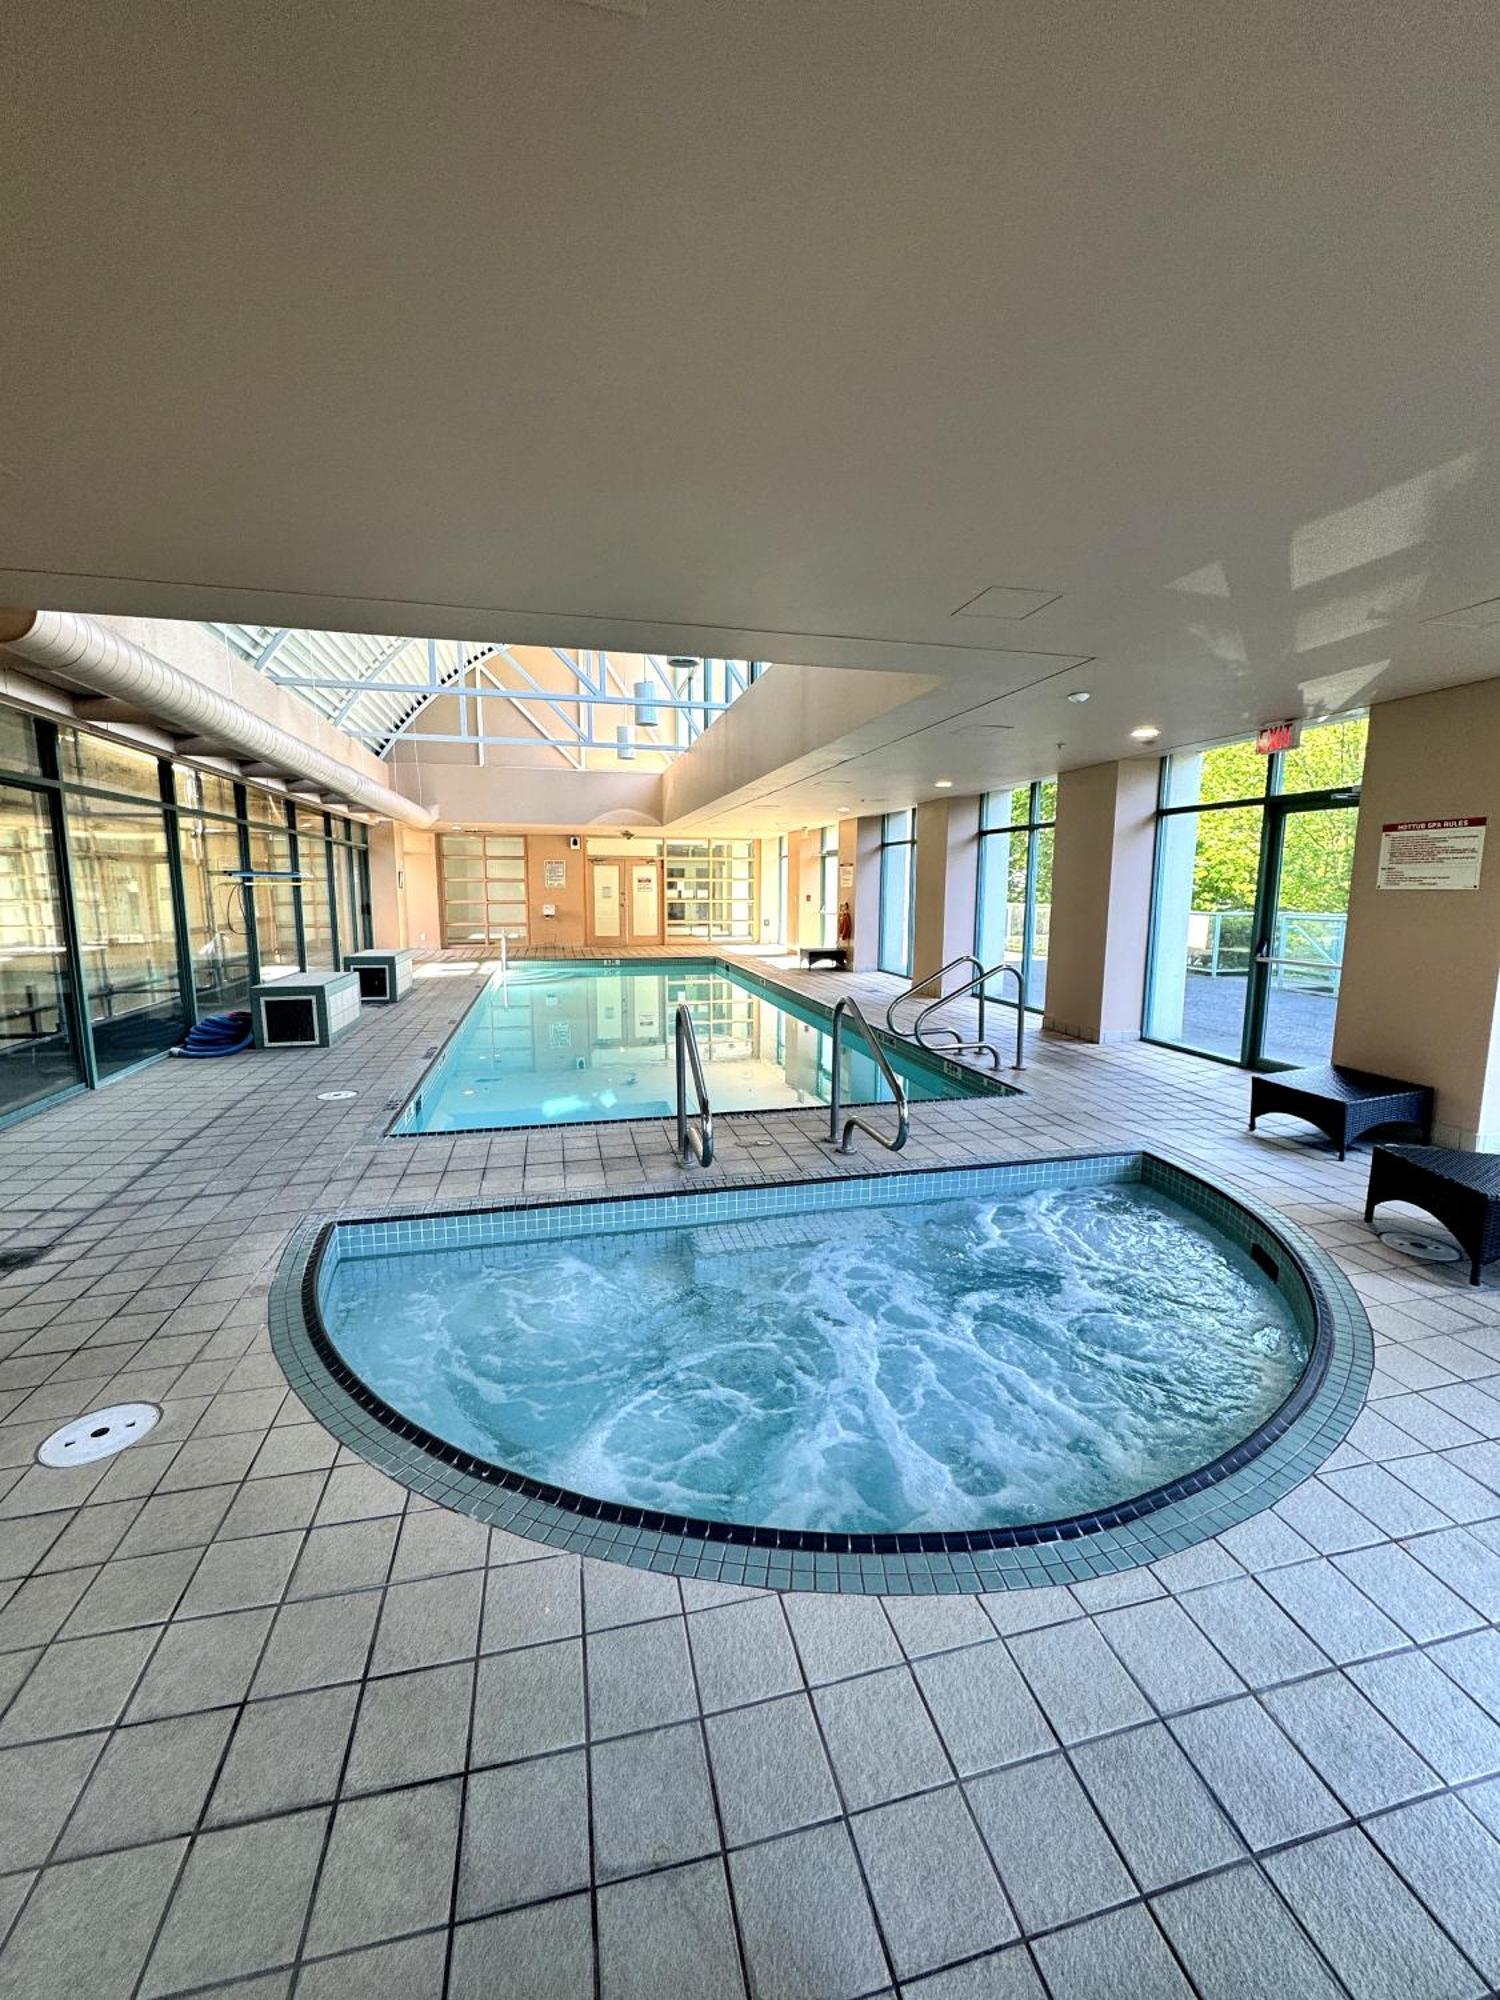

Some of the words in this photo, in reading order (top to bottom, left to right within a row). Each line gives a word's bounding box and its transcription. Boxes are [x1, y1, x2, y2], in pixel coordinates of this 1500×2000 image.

[1258, 724, 1293, 753] EXIT
[1427, 821, 1441, 829] SPA
[1444, 820, 1469, 828] RULES
